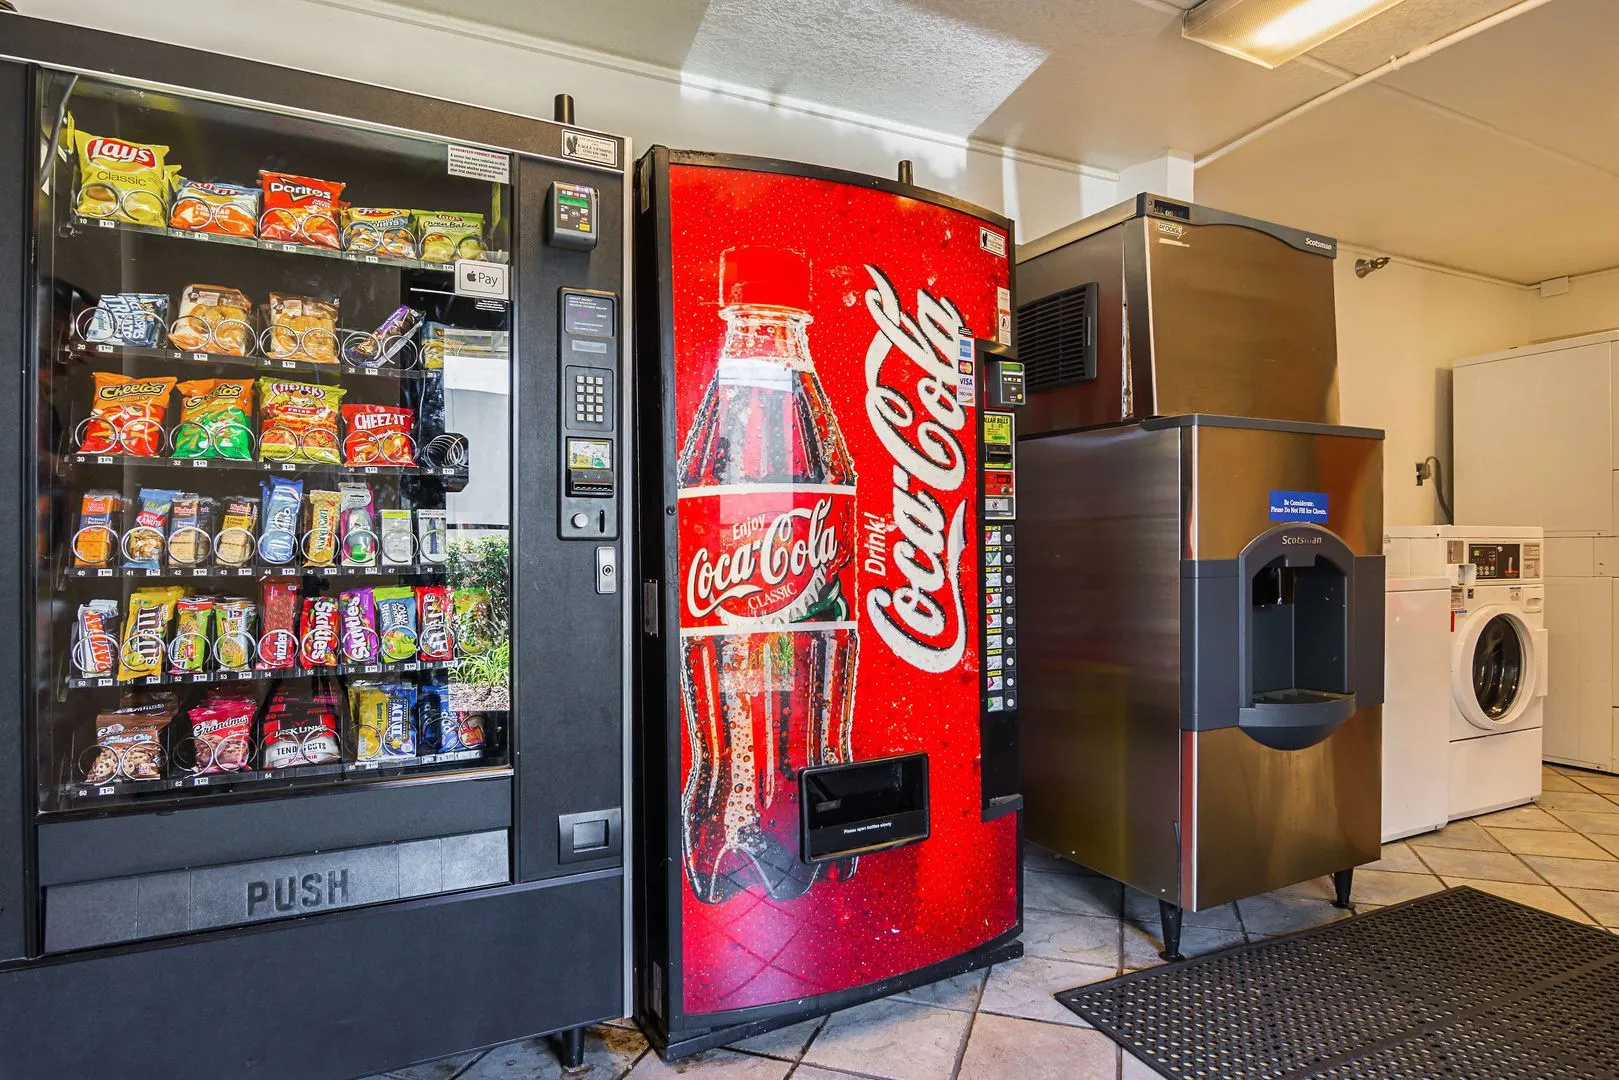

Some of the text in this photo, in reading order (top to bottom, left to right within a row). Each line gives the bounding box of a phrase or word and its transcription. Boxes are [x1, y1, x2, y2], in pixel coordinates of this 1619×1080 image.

[96, 171, 147, 187] Classic
[270, 181, 332, 200] Doritos
[1305, 237, 1333, 250] Scotsman
[478, 272, 498, 288] Pay
[99, 383, 166, 399] Cheetos
[959, 378, 973, 386] VISA
[863, 263, 969, 675] Coca-Cola
[1270, 505, 1284, 513] Please
[731, 512, 766, 541] Enjoy
[864, 511, 886, 577] Drink!
[1281, 535, 1323, 545] Scotsman
[686, 495, 839, 618] Coca-Cola
[747, 582, 798, 611] CLASSIC
[311, 600, 333, 660] Skittles
[345, 595, 371, 662] Skittles
[133, 733, 153, 743] Chip
[245, 867, 350, 917] PUSH
